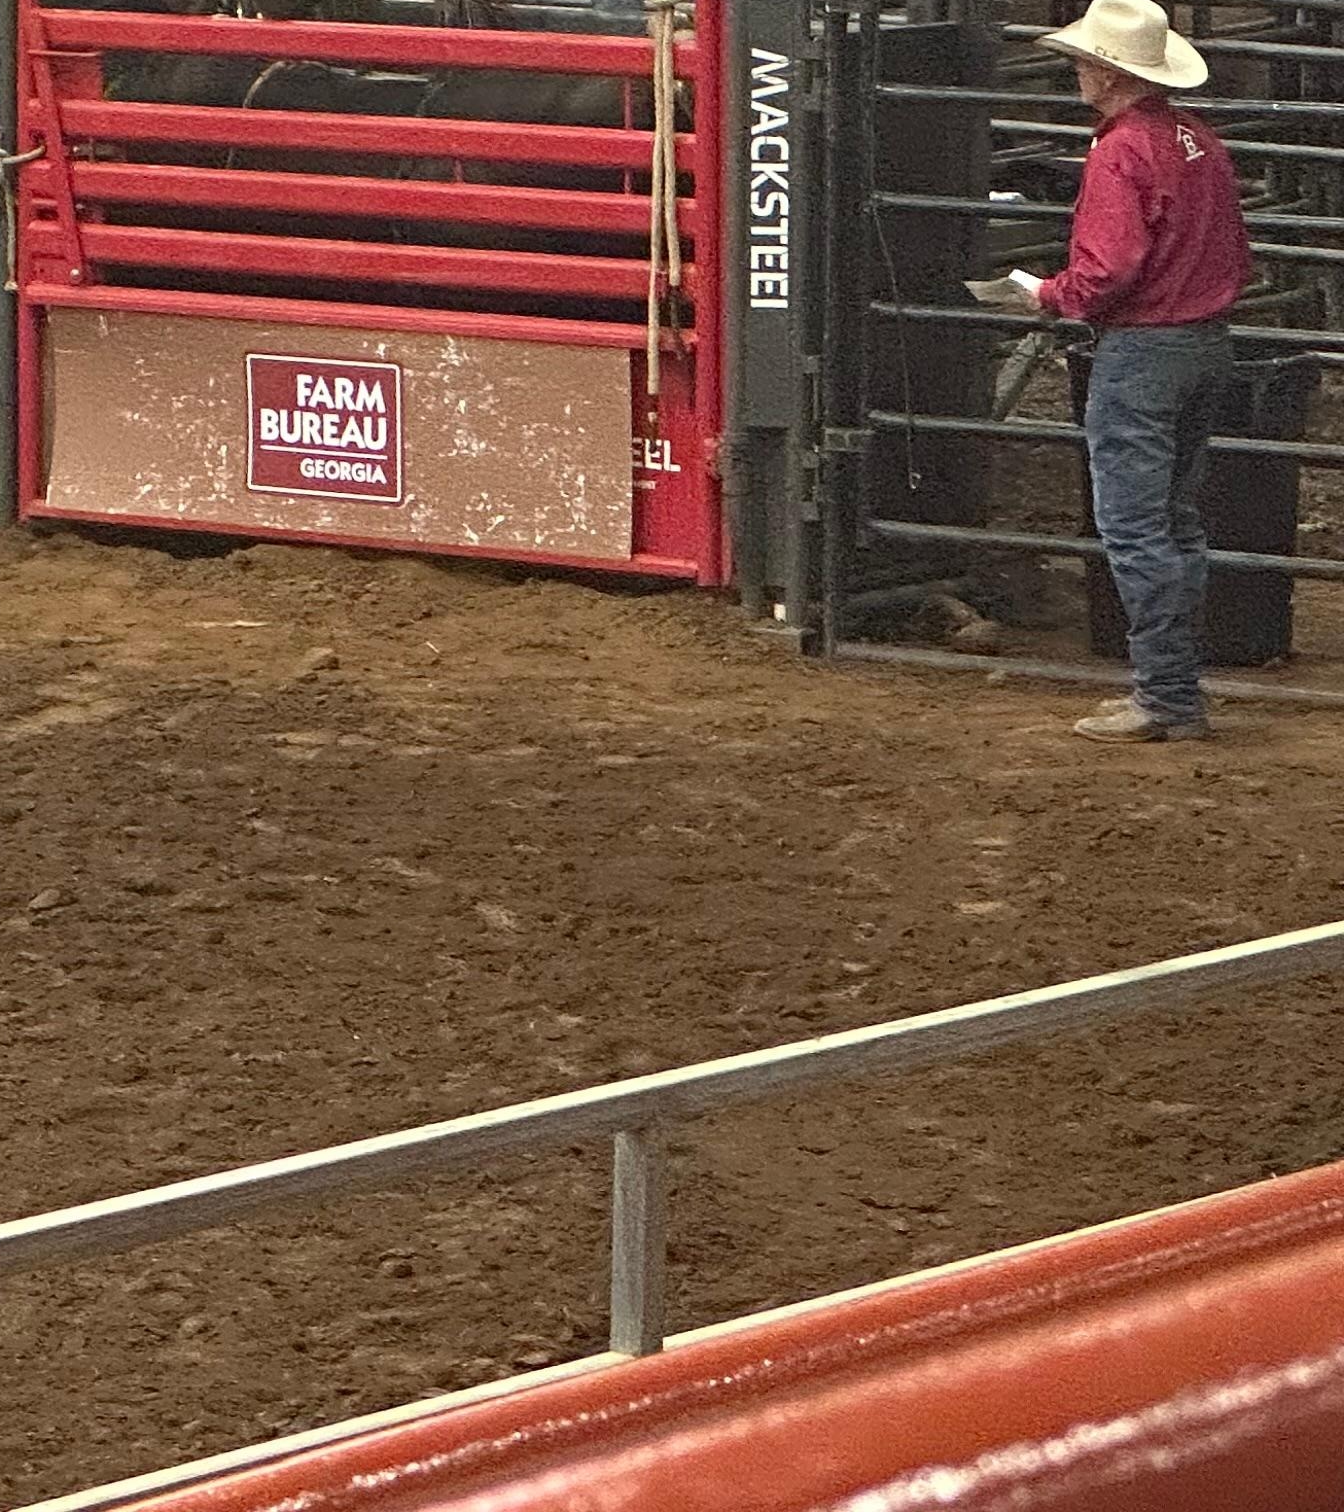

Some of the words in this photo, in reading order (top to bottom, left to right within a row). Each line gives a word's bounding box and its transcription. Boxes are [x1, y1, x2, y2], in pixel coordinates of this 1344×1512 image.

[296, 373, 387, 414] FARM
[260, 407, 387, 451] BUREAU
[300, 457, 388, 485] GEORGIA
